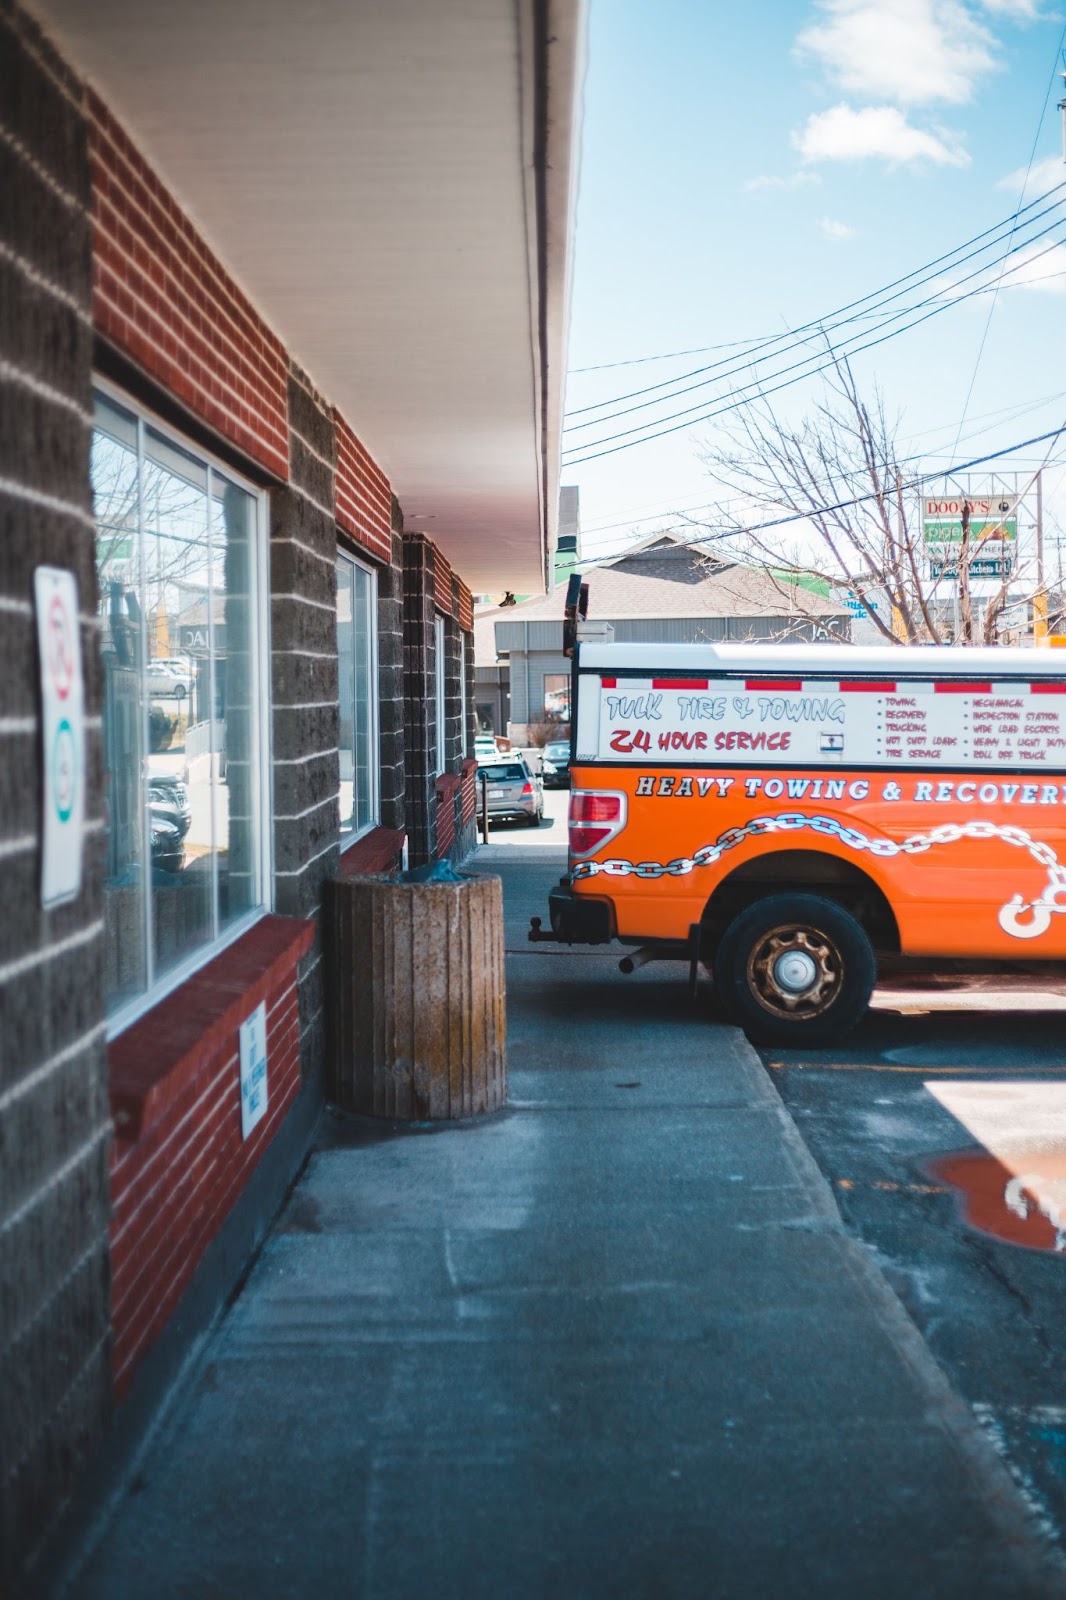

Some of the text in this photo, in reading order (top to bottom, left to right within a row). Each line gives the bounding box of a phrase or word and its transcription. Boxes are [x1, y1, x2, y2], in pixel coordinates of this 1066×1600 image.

[928, 501, 989, 514] DOOY'S
[885, 697, 917, 707] TOWING
[606, 693, 664, 721] TULK
[677, 696, 727, 721] TIRE
[757, 697, 847, 724] TOWING
[885, 710, 927, 720] RECOVERY
[972, 711, 1059, 722] INSPECTION STATION
[885, 722, 927, 733] TRUCKING
[973, 724, 1060, 734] WIDE LOAD ESCORTS
[609, 729, 792, 754] 24 HOUR SERVICE
[906, 736, 927, 746] SHOT
[932, 736, 958, 746] LOADS
[973, 737, 999, 748] HEAVY
[1017, 738, 1041, 748] LIGHT
[908, 749, 942, 758] SERVICE
[973, 750, 1047, 760] ROLL OFF TRUCK
[635, 776, 735, 798] HEAVY
[745, 777, 870, 801] TOWING
[882, 780, 902, 801] &
